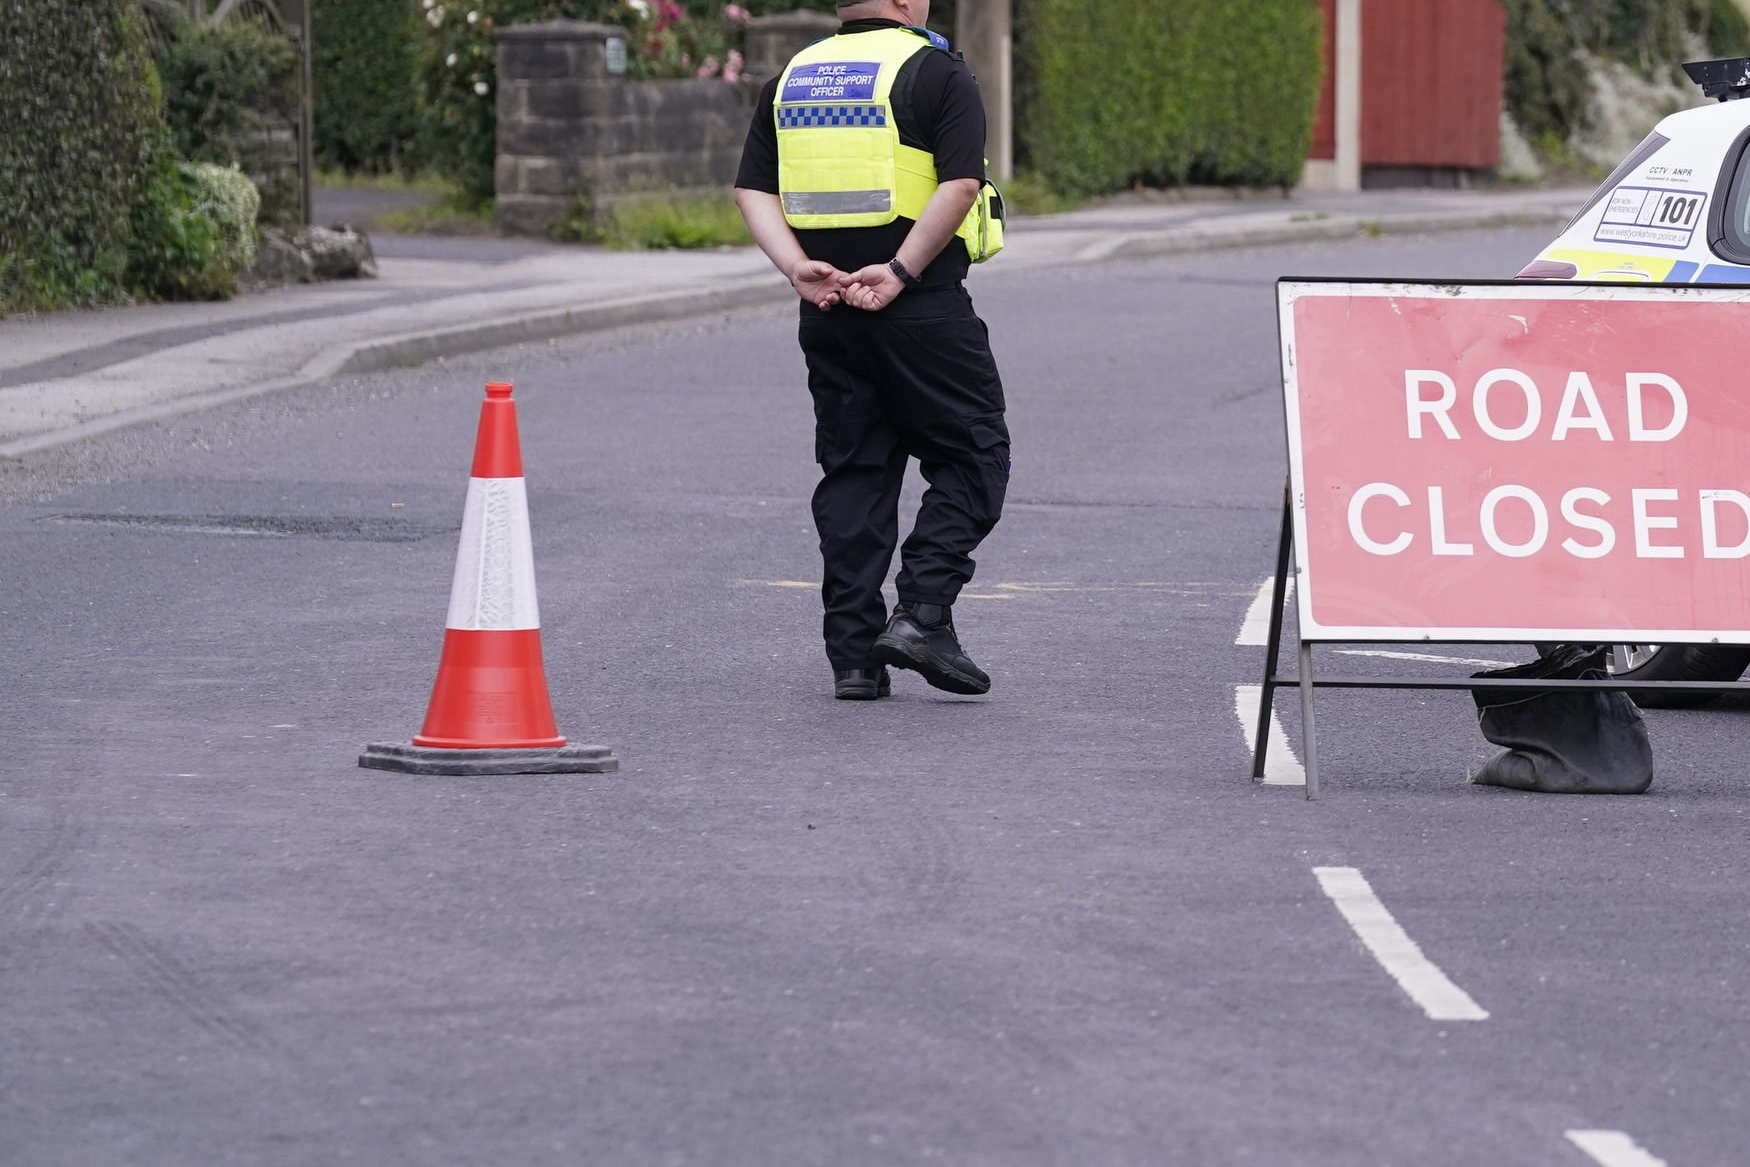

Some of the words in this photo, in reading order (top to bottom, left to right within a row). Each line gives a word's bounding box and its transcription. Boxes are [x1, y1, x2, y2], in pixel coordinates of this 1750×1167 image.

[818, 66, 847, 75] POLICE
[788, 76, 834, 87] COMMUNITY
[835, 75, 873, 86] SUPPORT
[810, 86, 845, 96] OFFICER
[1649, 166, 1668, 175] CCTV
[1672, 167, 1693, 176] ANPR
[1659, 196, 1698, 225] 101
[1403, 367, 1689, 443] ROAD
